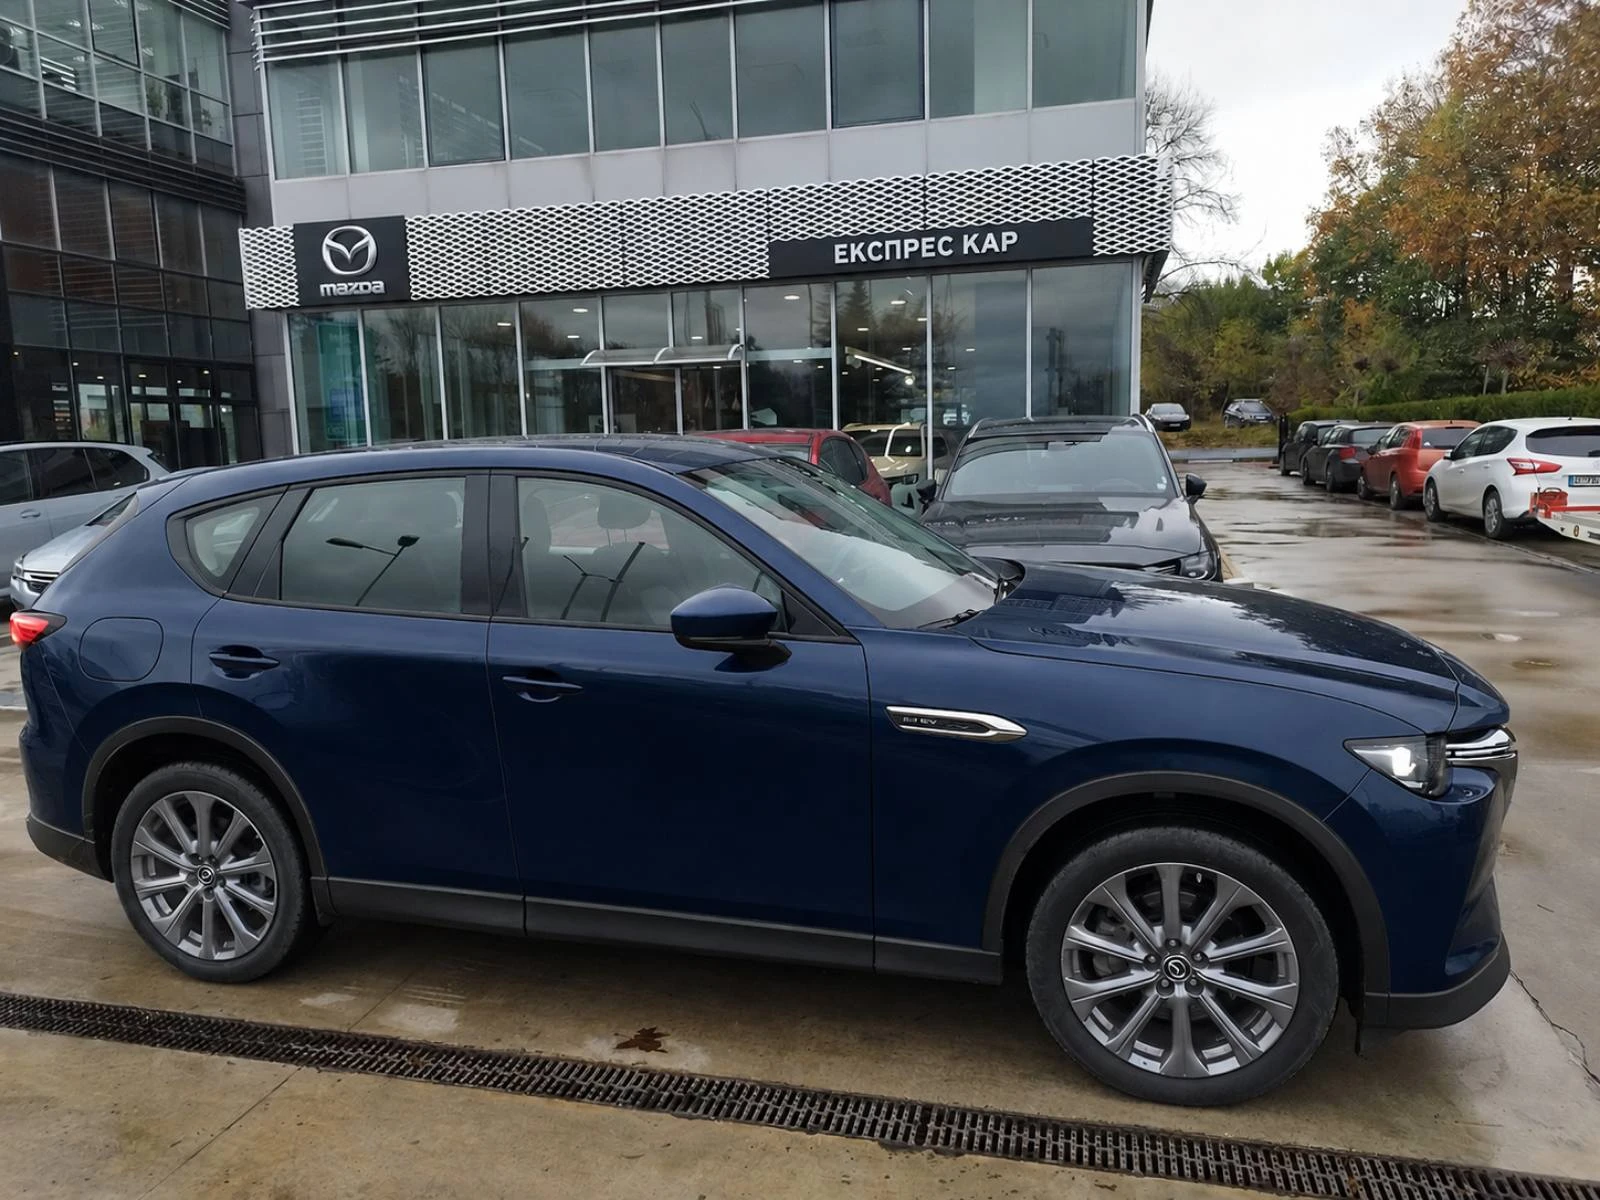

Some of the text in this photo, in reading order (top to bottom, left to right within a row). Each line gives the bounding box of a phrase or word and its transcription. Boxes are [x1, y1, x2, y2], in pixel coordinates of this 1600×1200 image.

[834, 231, 1018, 264] ЕКСПРЕС КАР
[320, 280, 385, 297] mazda
